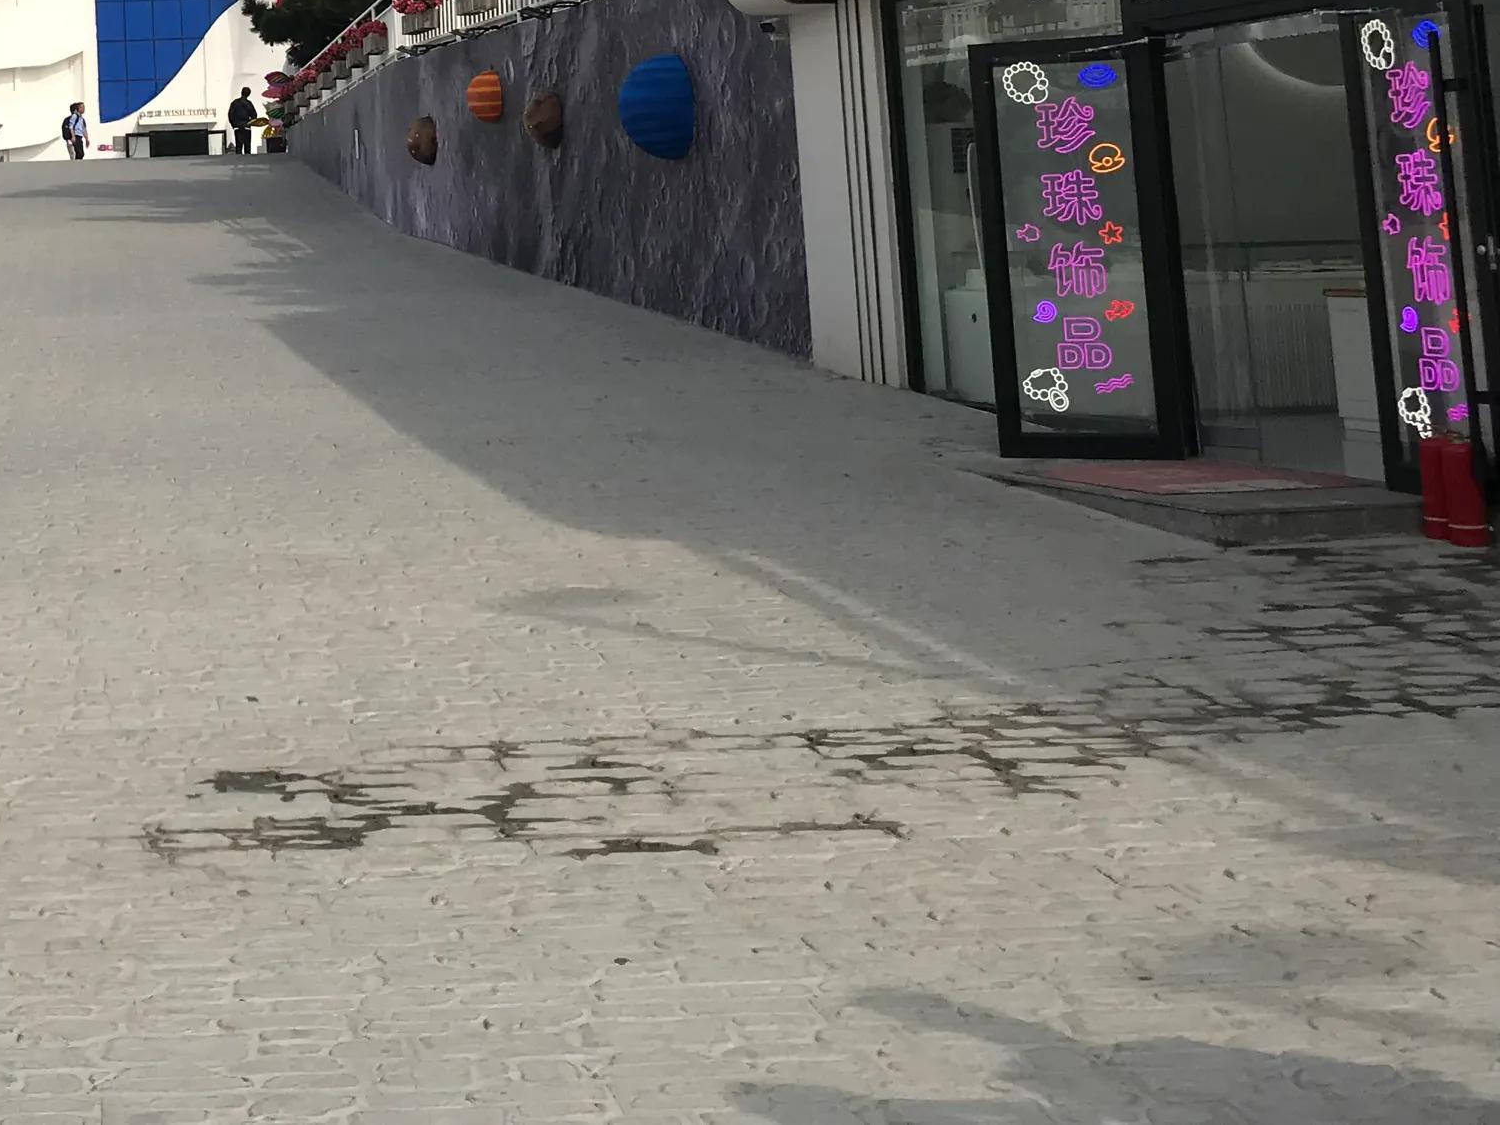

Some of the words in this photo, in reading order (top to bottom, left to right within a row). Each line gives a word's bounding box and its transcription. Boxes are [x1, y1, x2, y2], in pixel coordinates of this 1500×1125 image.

[164, 108, 186, 117] WISH
[188, 107, 217, 117] TOWER
[1035, 96, 1112, 370] 珍珠饰品
[1385, 60, 1460, 392] 珍珠饰品
